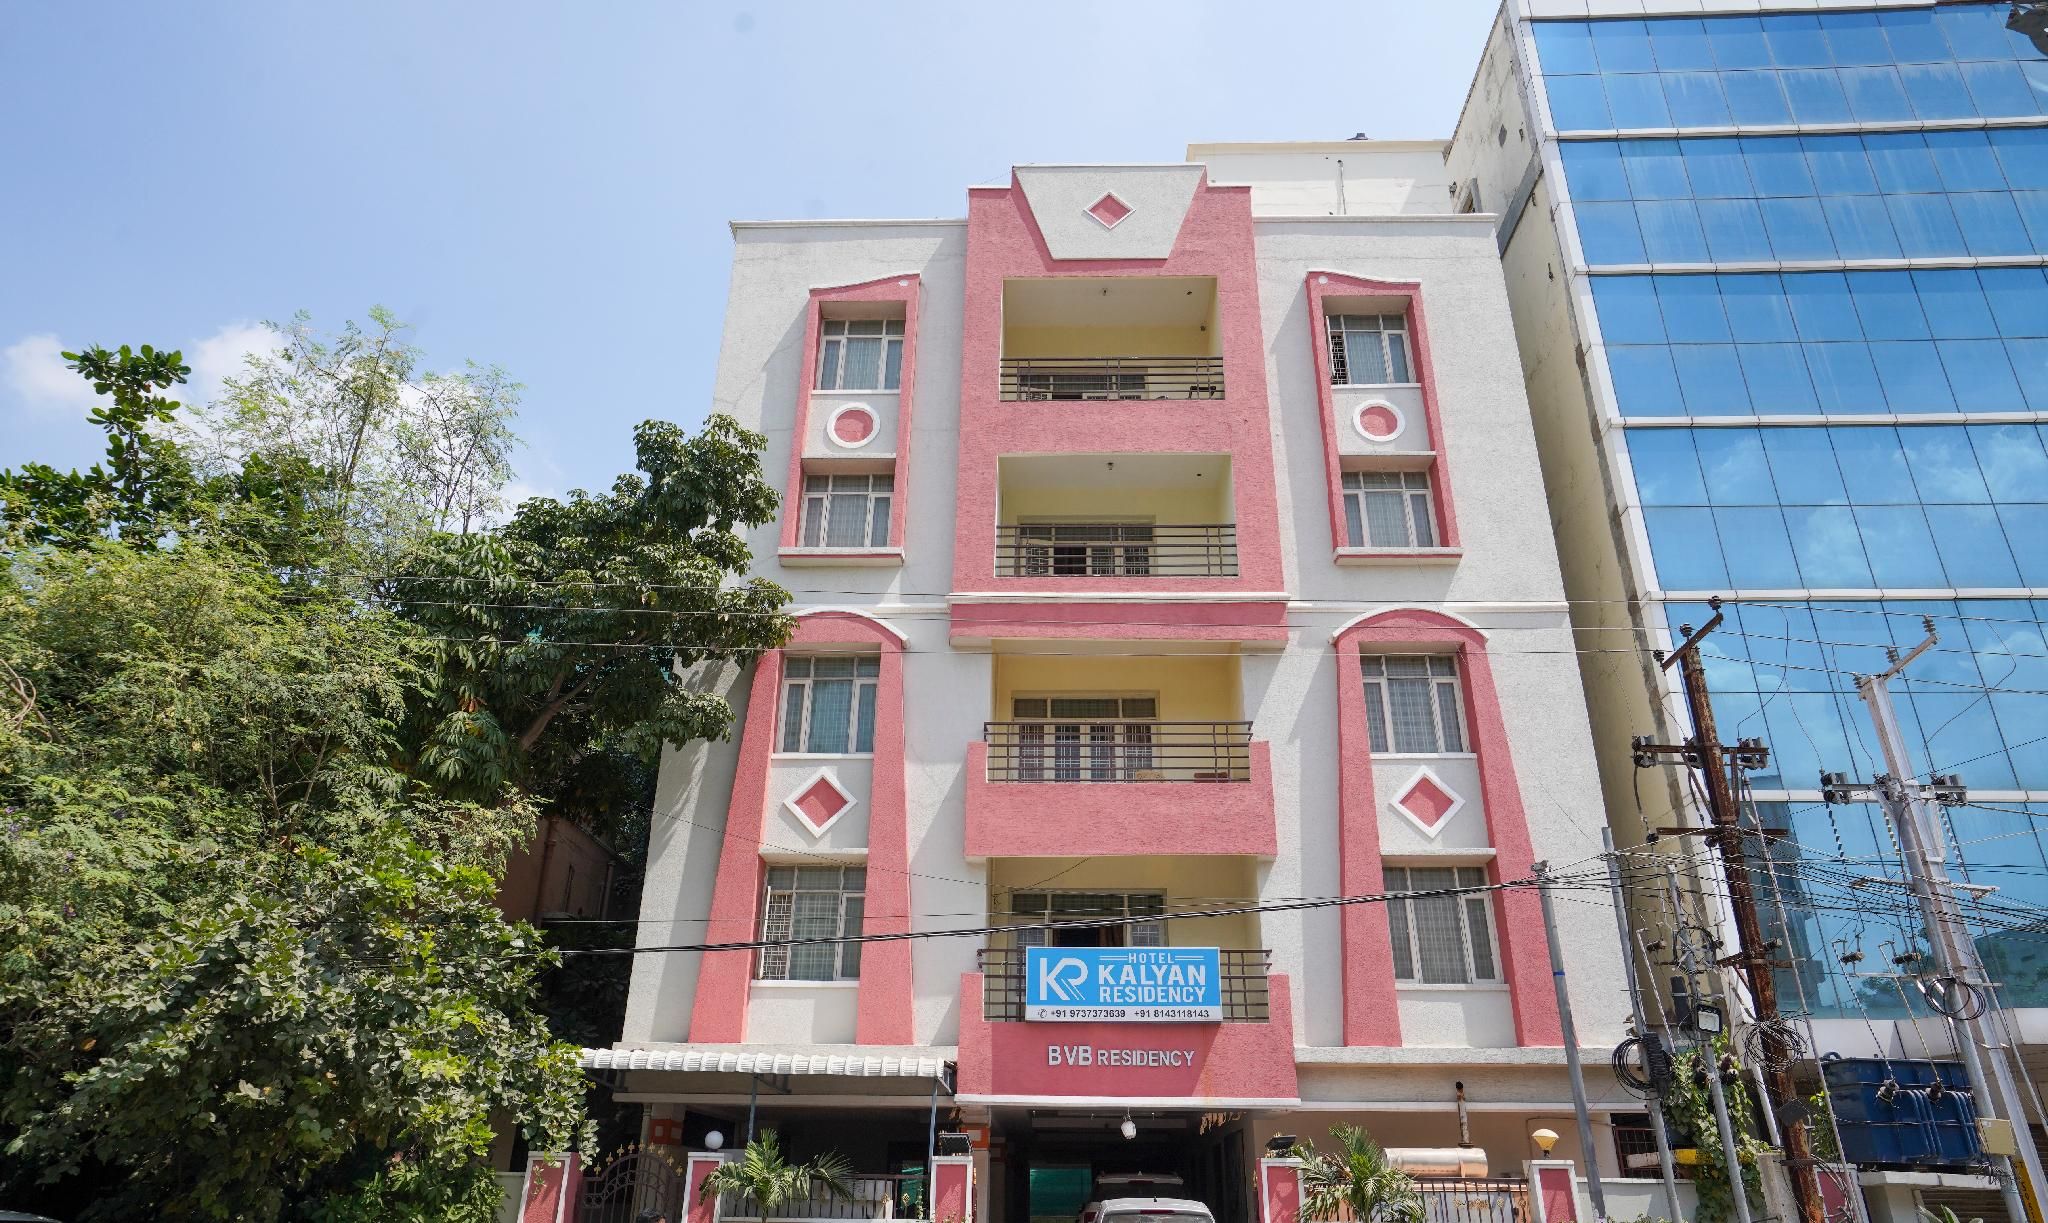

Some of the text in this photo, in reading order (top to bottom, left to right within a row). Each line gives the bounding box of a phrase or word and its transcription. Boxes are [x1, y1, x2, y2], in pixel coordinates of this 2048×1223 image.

[1128, 952, 1175, 964] HOTEL
[1098, 964, 1206, 986] KALYAN
[1099, 986, 1206, 1003] RESIDENCY
[1051, 1009, 1066, 1018] +91
[1069, 1009, 1126, 1018] 9737373639
[1134, 1009, 1151, 1018] +91
[1048, 1045, 1195, 1067] BVB RESIDENCY
